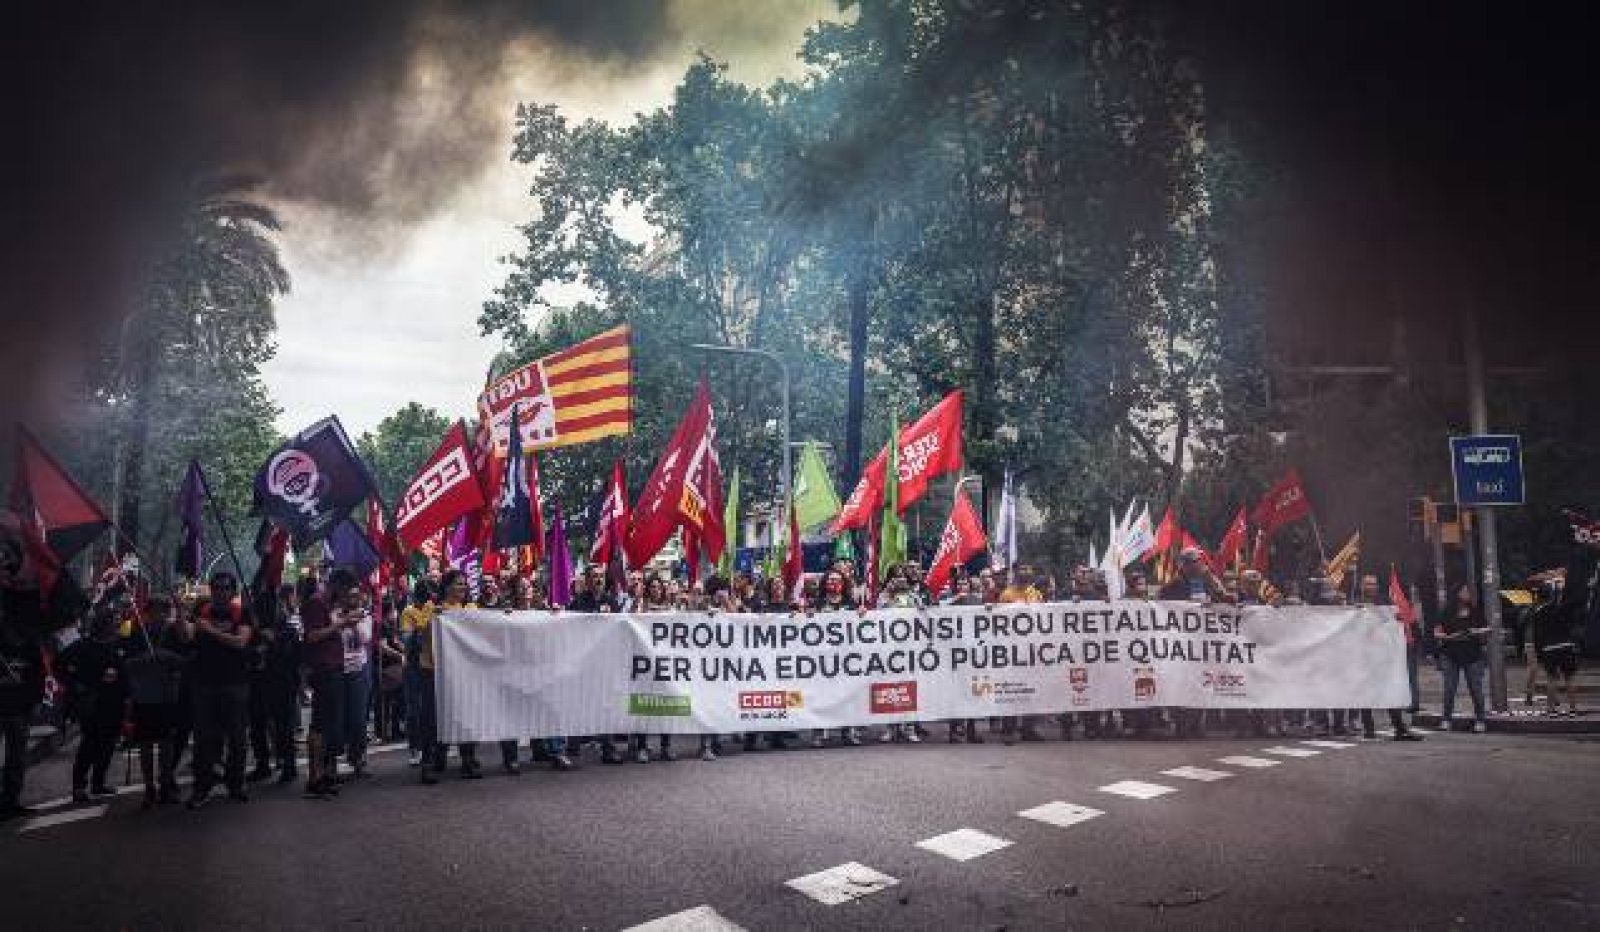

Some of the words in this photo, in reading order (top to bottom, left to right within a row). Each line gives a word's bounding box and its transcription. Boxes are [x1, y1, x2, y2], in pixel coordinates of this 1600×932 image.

[651, 622, 734, 648] PROU
[743, 618, 962, 648] IMPOSICIONS!
[974, 613, 1053, 638] PROU
[1064, 609, 1243, 635] RETALLADES!
[631, 655, 692, 682] PER
[700, 655, 767, 682] UNA
[775, 642, 941, 679] EDUCACIÓ
[951, 640, 1075, 672] PÚBLICA
[1084, 641, 1120, 664] DE
[1127, 637, 1257, 664] QUALITAT
